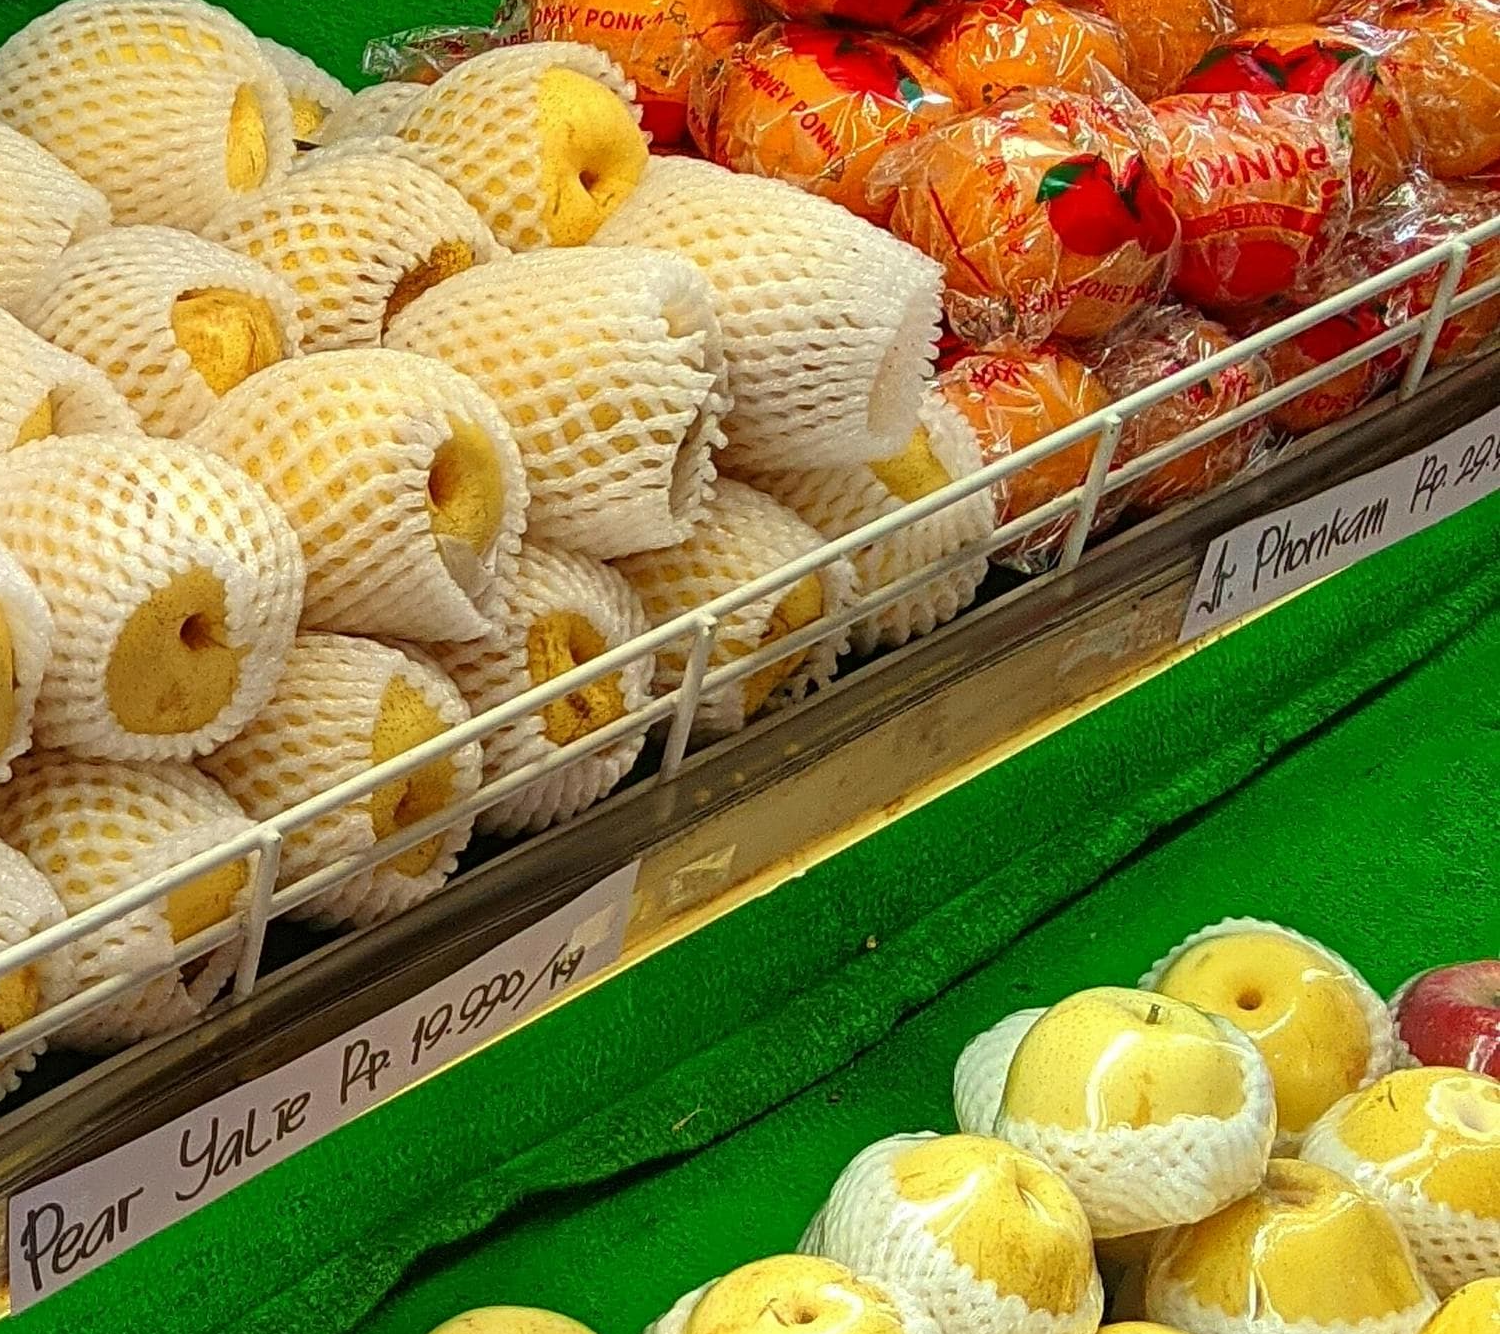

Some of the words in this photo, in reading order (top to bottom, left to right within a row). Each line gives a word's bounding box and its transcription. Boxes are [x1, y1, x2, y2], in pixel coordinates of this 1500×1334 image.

[1218, 207, 1286, 229] SWEE
[1252, 497, 1389, 593] Phonkam
[20, 1186, 145, 1292] Pear
